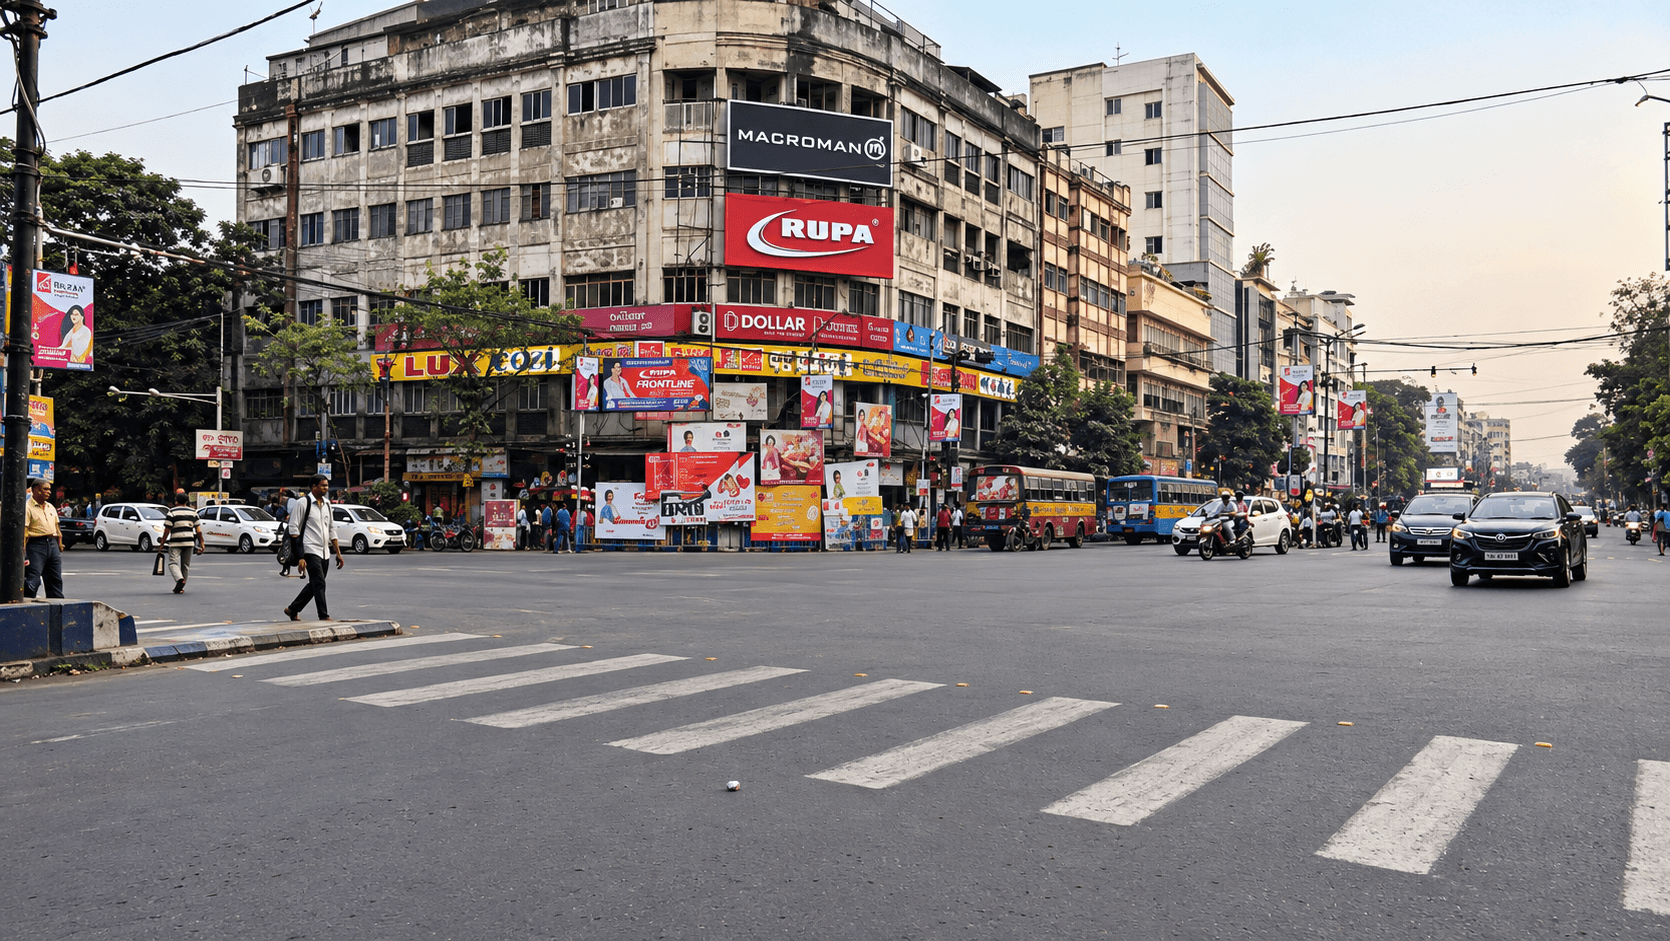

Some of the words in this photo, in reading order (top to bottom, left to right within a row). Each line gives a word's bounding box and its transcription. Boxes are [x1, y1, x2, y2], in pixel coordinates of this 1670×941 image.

[738, 129, 861, 155] MACROMAN
[781, 218, 874, 244] RUPA
[741, 314, 806, 331] DOLLAR
[404, 351, 481, 377] LUX
[636, 379, 696, 389] FRONTLINE
